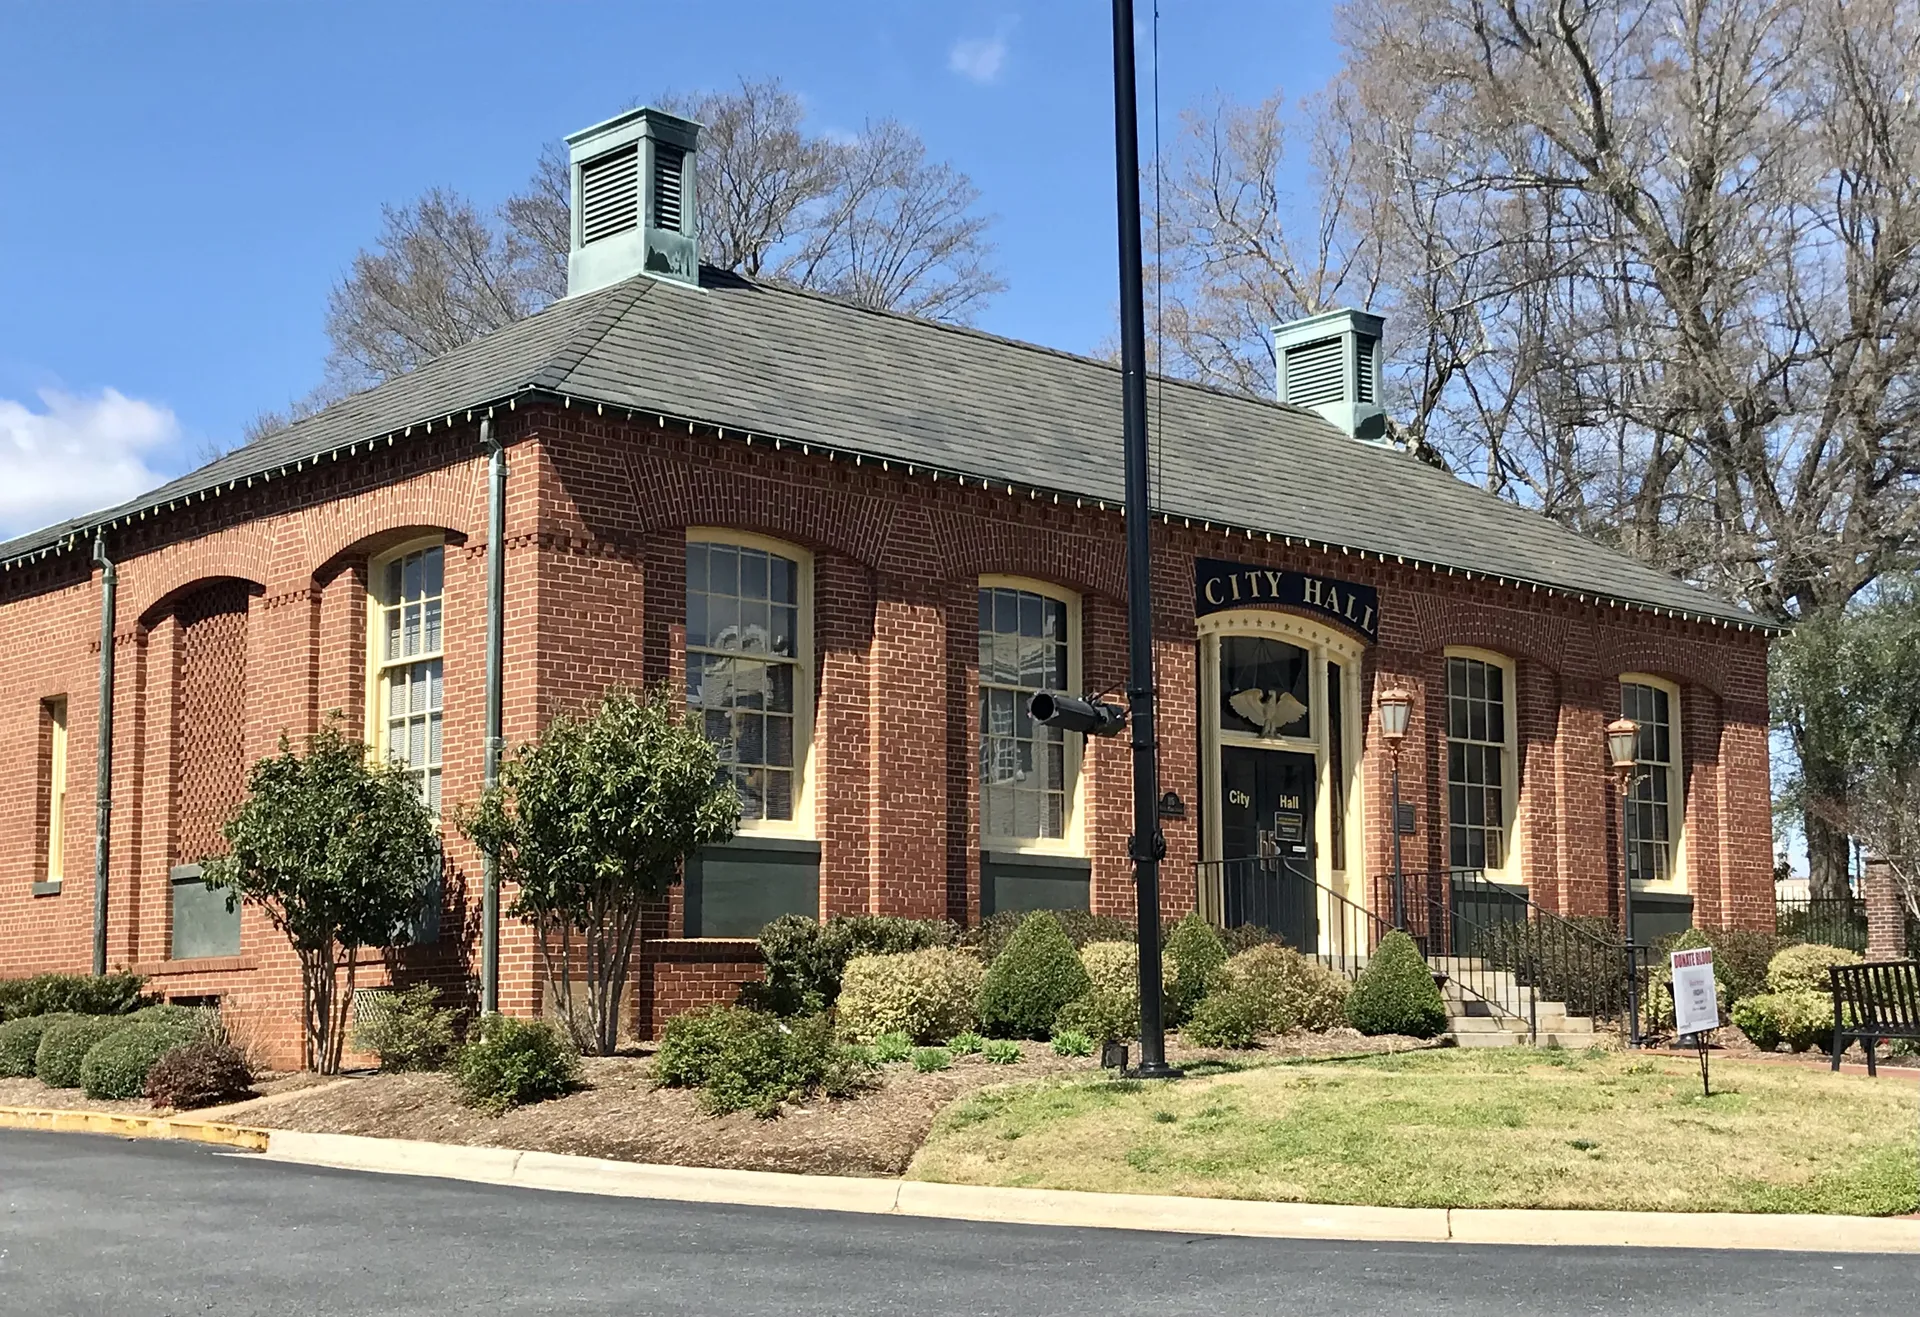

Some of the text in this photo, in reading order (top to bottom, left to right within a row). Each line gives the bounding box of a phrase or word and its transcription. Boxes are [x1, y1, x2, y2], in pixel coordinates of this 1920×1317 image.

[1205, 571, 1374, 635] CITY HALL
[1229, 790, 1299, 809] City Hall
[1674, 950, 1712, 968] DONATE BLOOD
